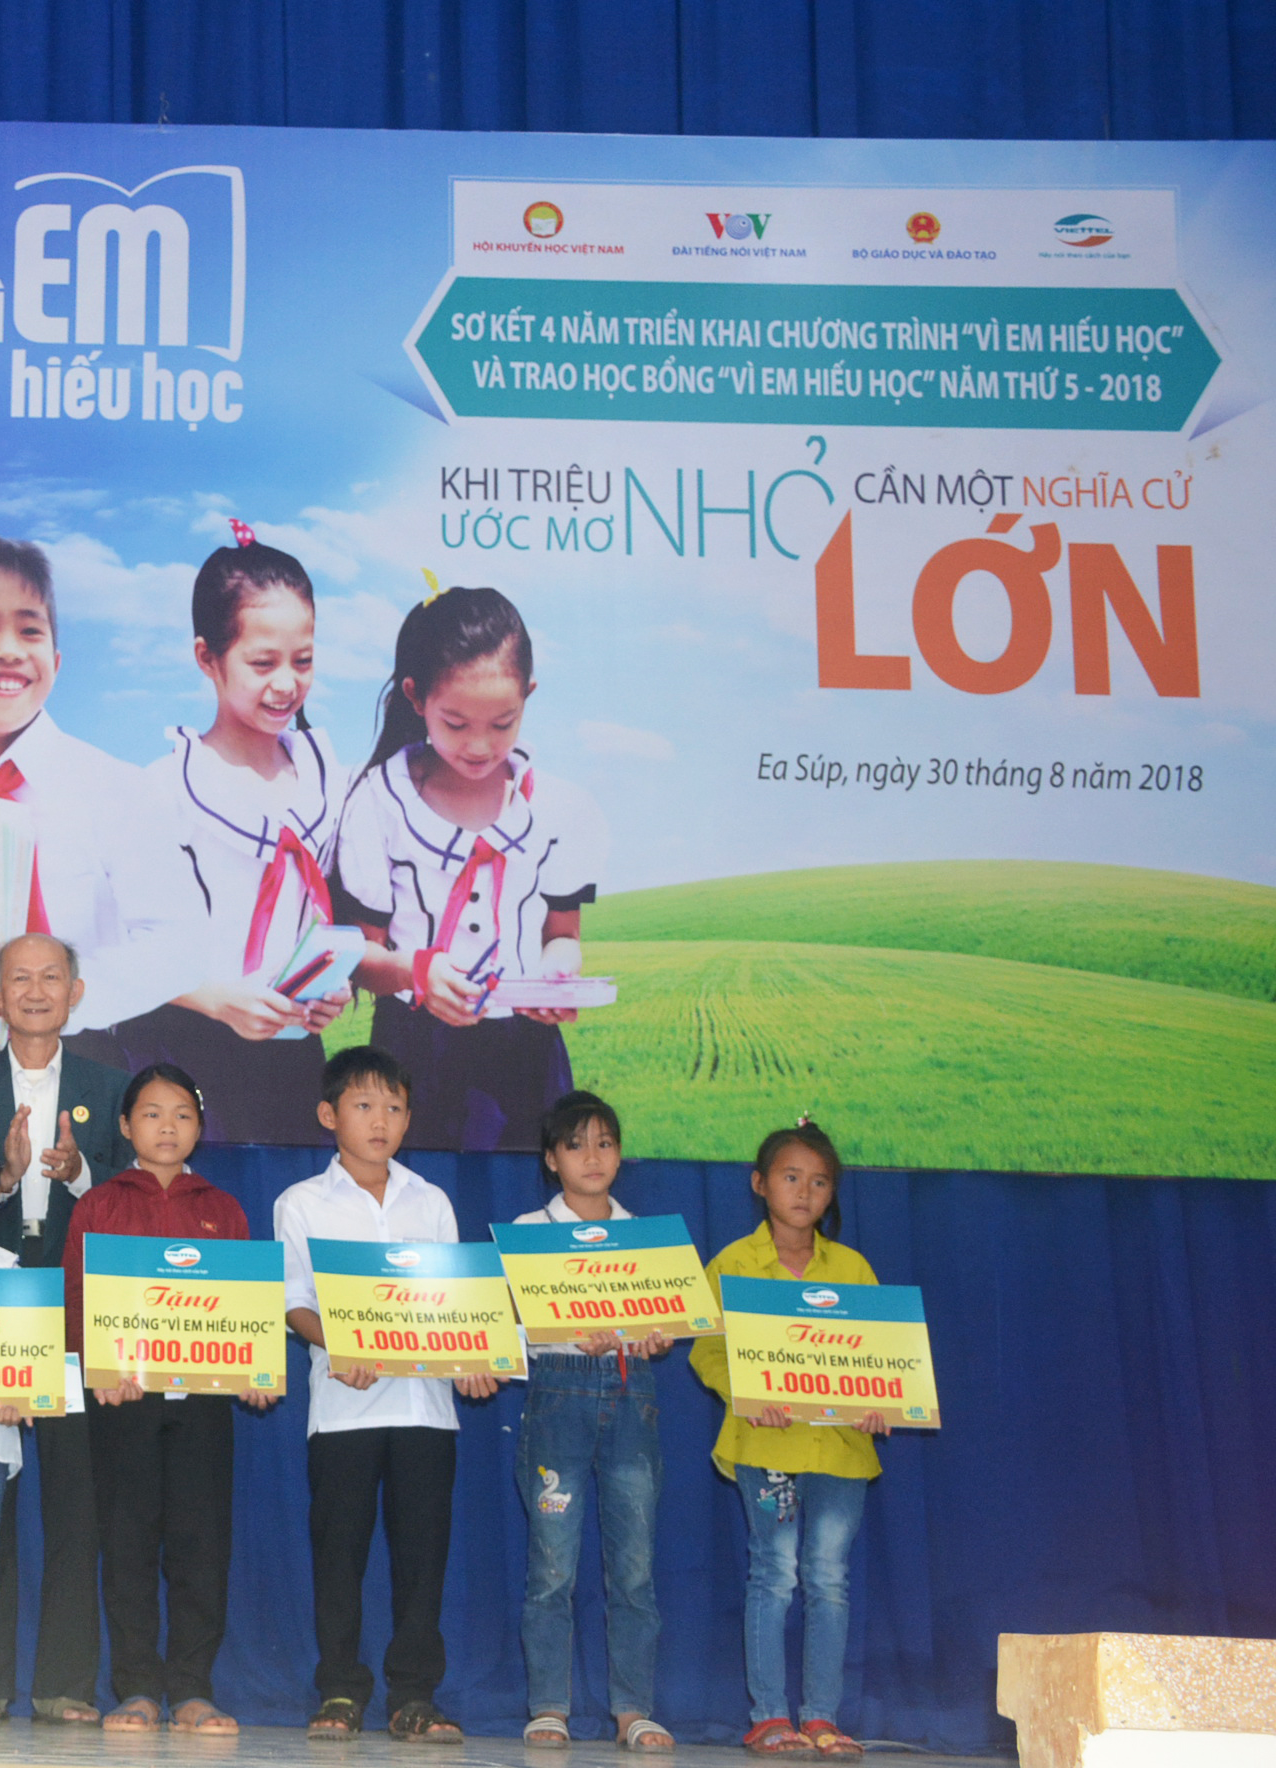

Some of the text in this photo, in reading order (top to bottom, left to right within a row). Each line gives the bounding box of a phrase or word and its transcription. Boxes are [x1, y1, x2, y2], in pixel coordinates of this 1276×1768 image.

[473, 241, 624, 255] HỘI KHUYẾN HỌC VIỆT NAM
[672, 245, 692, 255] ĐÀI
[694, 245, 727, 256] TIẾNG
[731, 246, 750, 256] NÓI
[753, 246, 777, 258] VIỆT
[852, 248, 996, 261] BỘ GIÁO DỤC VÀ ĐÀO TẠO
[13, 204, 189, 346] EM
[451, 311, 486, 341] SƠ
[491, 306, 535, 342] KẾT
[540, 315, 556, 341] 4
[562, 311, 619, 344] NĂM
[624, 309, 695, 346] TRIỂN
[701, 319, 760, 347] KHAI
[767, 317, 877, 350] CHƯƠNG
[881, 317, 958, 351] TRÌNH
[1007, 324, 1043, 352] EM
[1050, 316, 1108, 353] HIẾU
[11, 349, 243, 431] hiếu học
[473, 356, 506, 388] VÀ
[510, 361, 577, 391] TRAO
[584, 364, 636, 399] HỌC
[642, 355, 714, 393] BỔNG
[762, 367, 797, 396] EM
[805, 360, 862, 396] HIẾU
[940, 366, 999, 398] NĂM
[1004, 367, 1059, 400] THỨ
[1065, 373, 1078, 400] 5
[1100, 374, 1161, 401] 2018
[440, 463, 612, 511] KHI TRIỆU
[623, 434, 836, 562] NHỎ
[854, 463, 1193, 515] CẦN MỘT NGHĨA CỬ
[441, 508, 614, 553] ƯỚC MƠ
[814, 507, 1201, 698] LỚN
[758, 753, 1203, 795] Ea Súp, ngày 30 tháng 8 năm 2018
[564, 1259, 638, 1277] Tặng
[143, 1286, 220, 1312] Tặng
[373, 1284, 447, 1305] Tặng
[521, 1284, 548, 1297] HỌC
[611, 1282, 629, 1292] EM
[632, 1278, 661, 1291] HIẾU
[329, 1308, 355, 1322] HỌC
[417, 1313, 435, 1323] EM
[438, 1310, 467, 1323] HIẾU
[548, 1295, 686, 1319] 1.000.000đ
[94, 1315, 119, 1331] HỌC
[184, 1321, 202, 1332] EM
[206, 1318, 236, 1333] HIẾU
[786, 1324, 863, 1349] Tặng
[115, 1338, 253, 1365] 1.000.000đ
[352, 1329, 489, 1351] 1.000.000đ
[738, 1348, 764, 1363] HỌC
[830, 1356, 849, 1367] EM
[853, 1354, 883, 1368] HIẾU
[760, 1370, 903, 1399] 1.000.000đ
